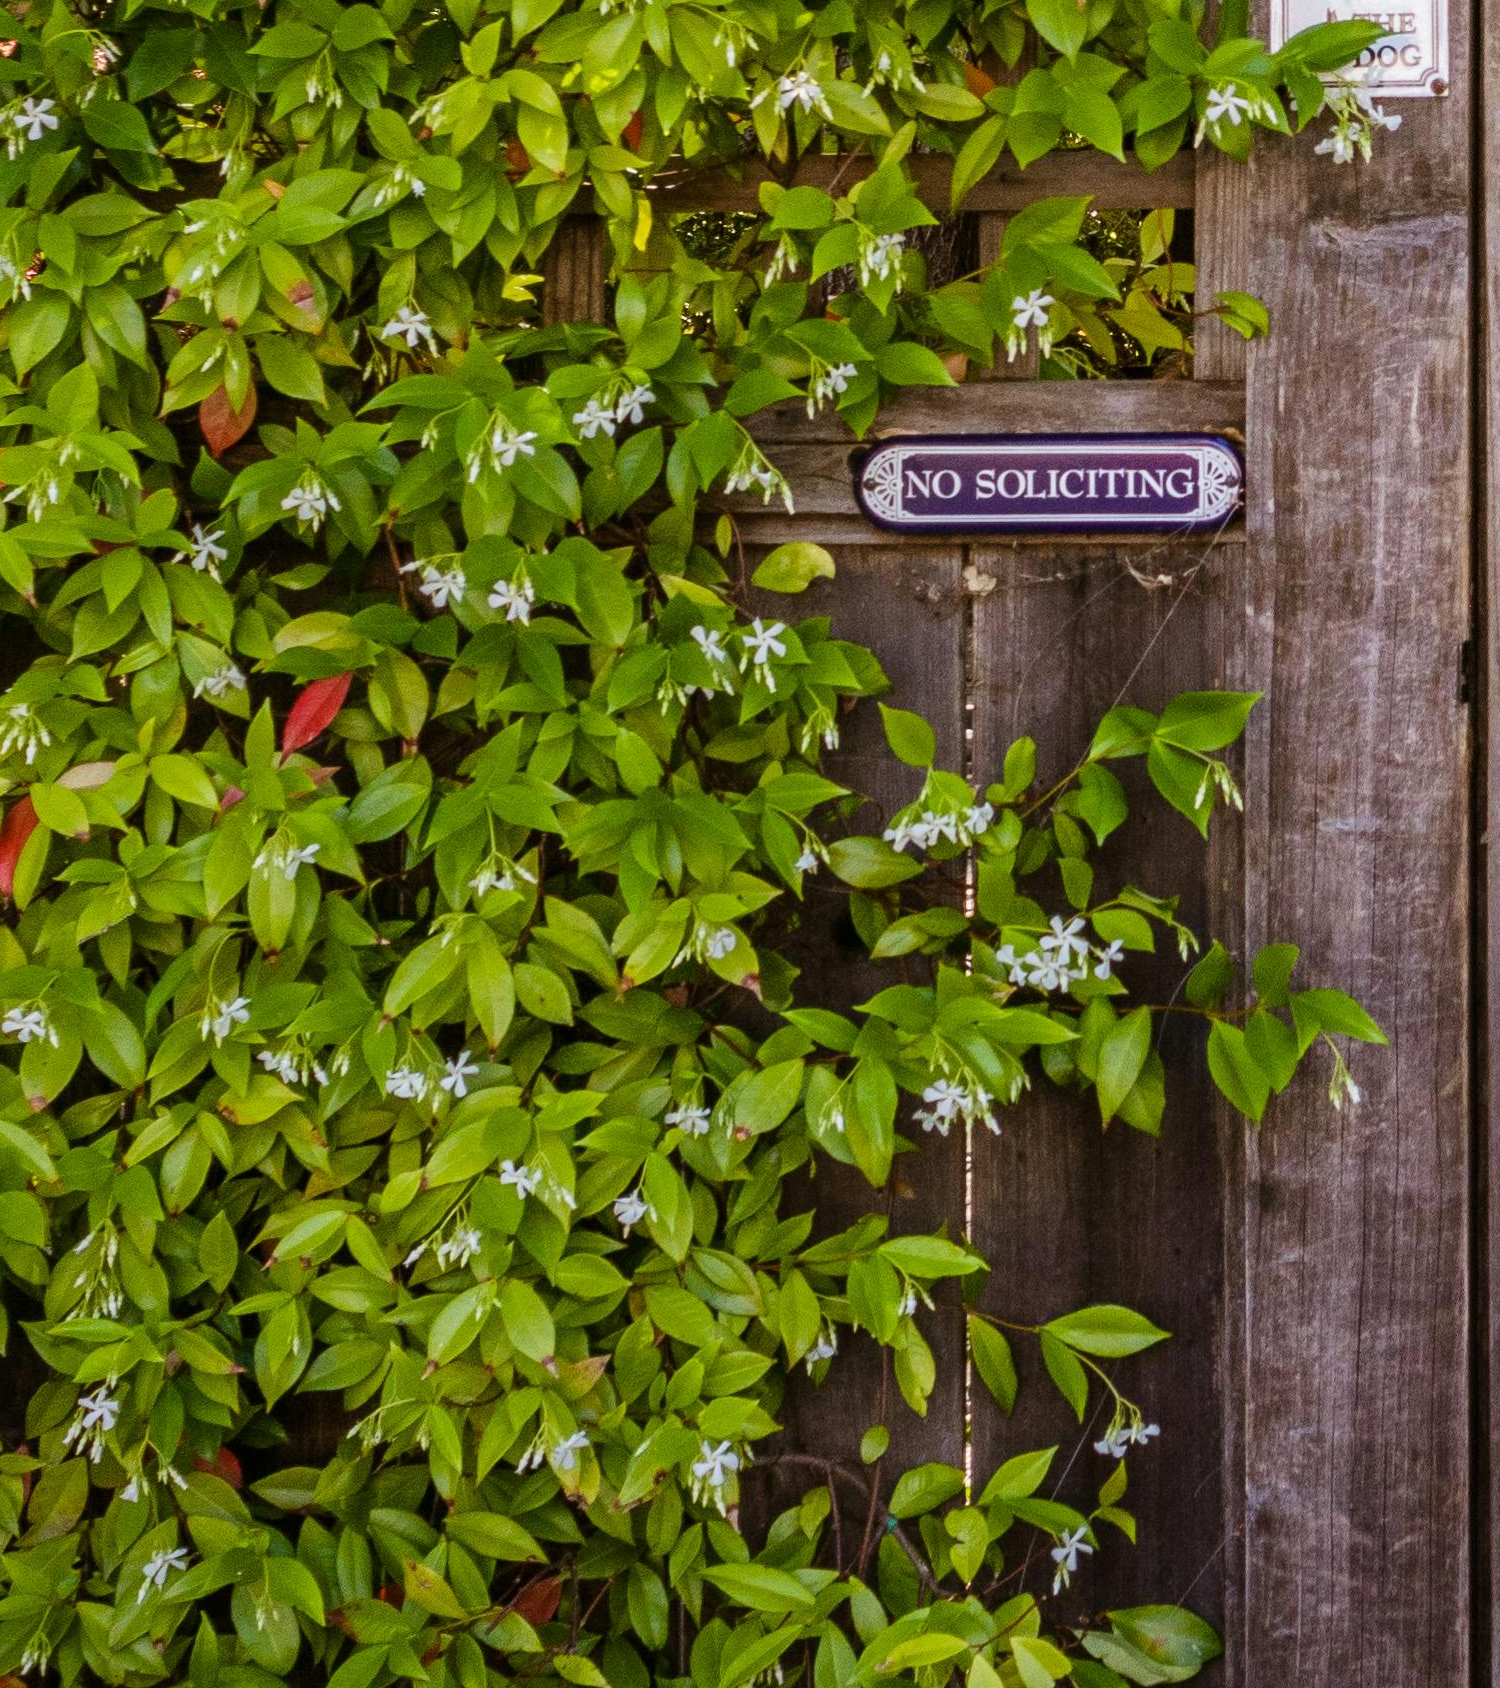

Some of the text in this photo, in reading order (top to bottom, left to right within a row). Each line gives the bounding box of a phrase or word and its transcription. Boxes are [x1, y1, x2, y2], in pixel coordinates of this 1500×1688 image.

[1353, 44, 1422, 68] DOG
[904, 468, 1195, 500] NO SOLICITING
